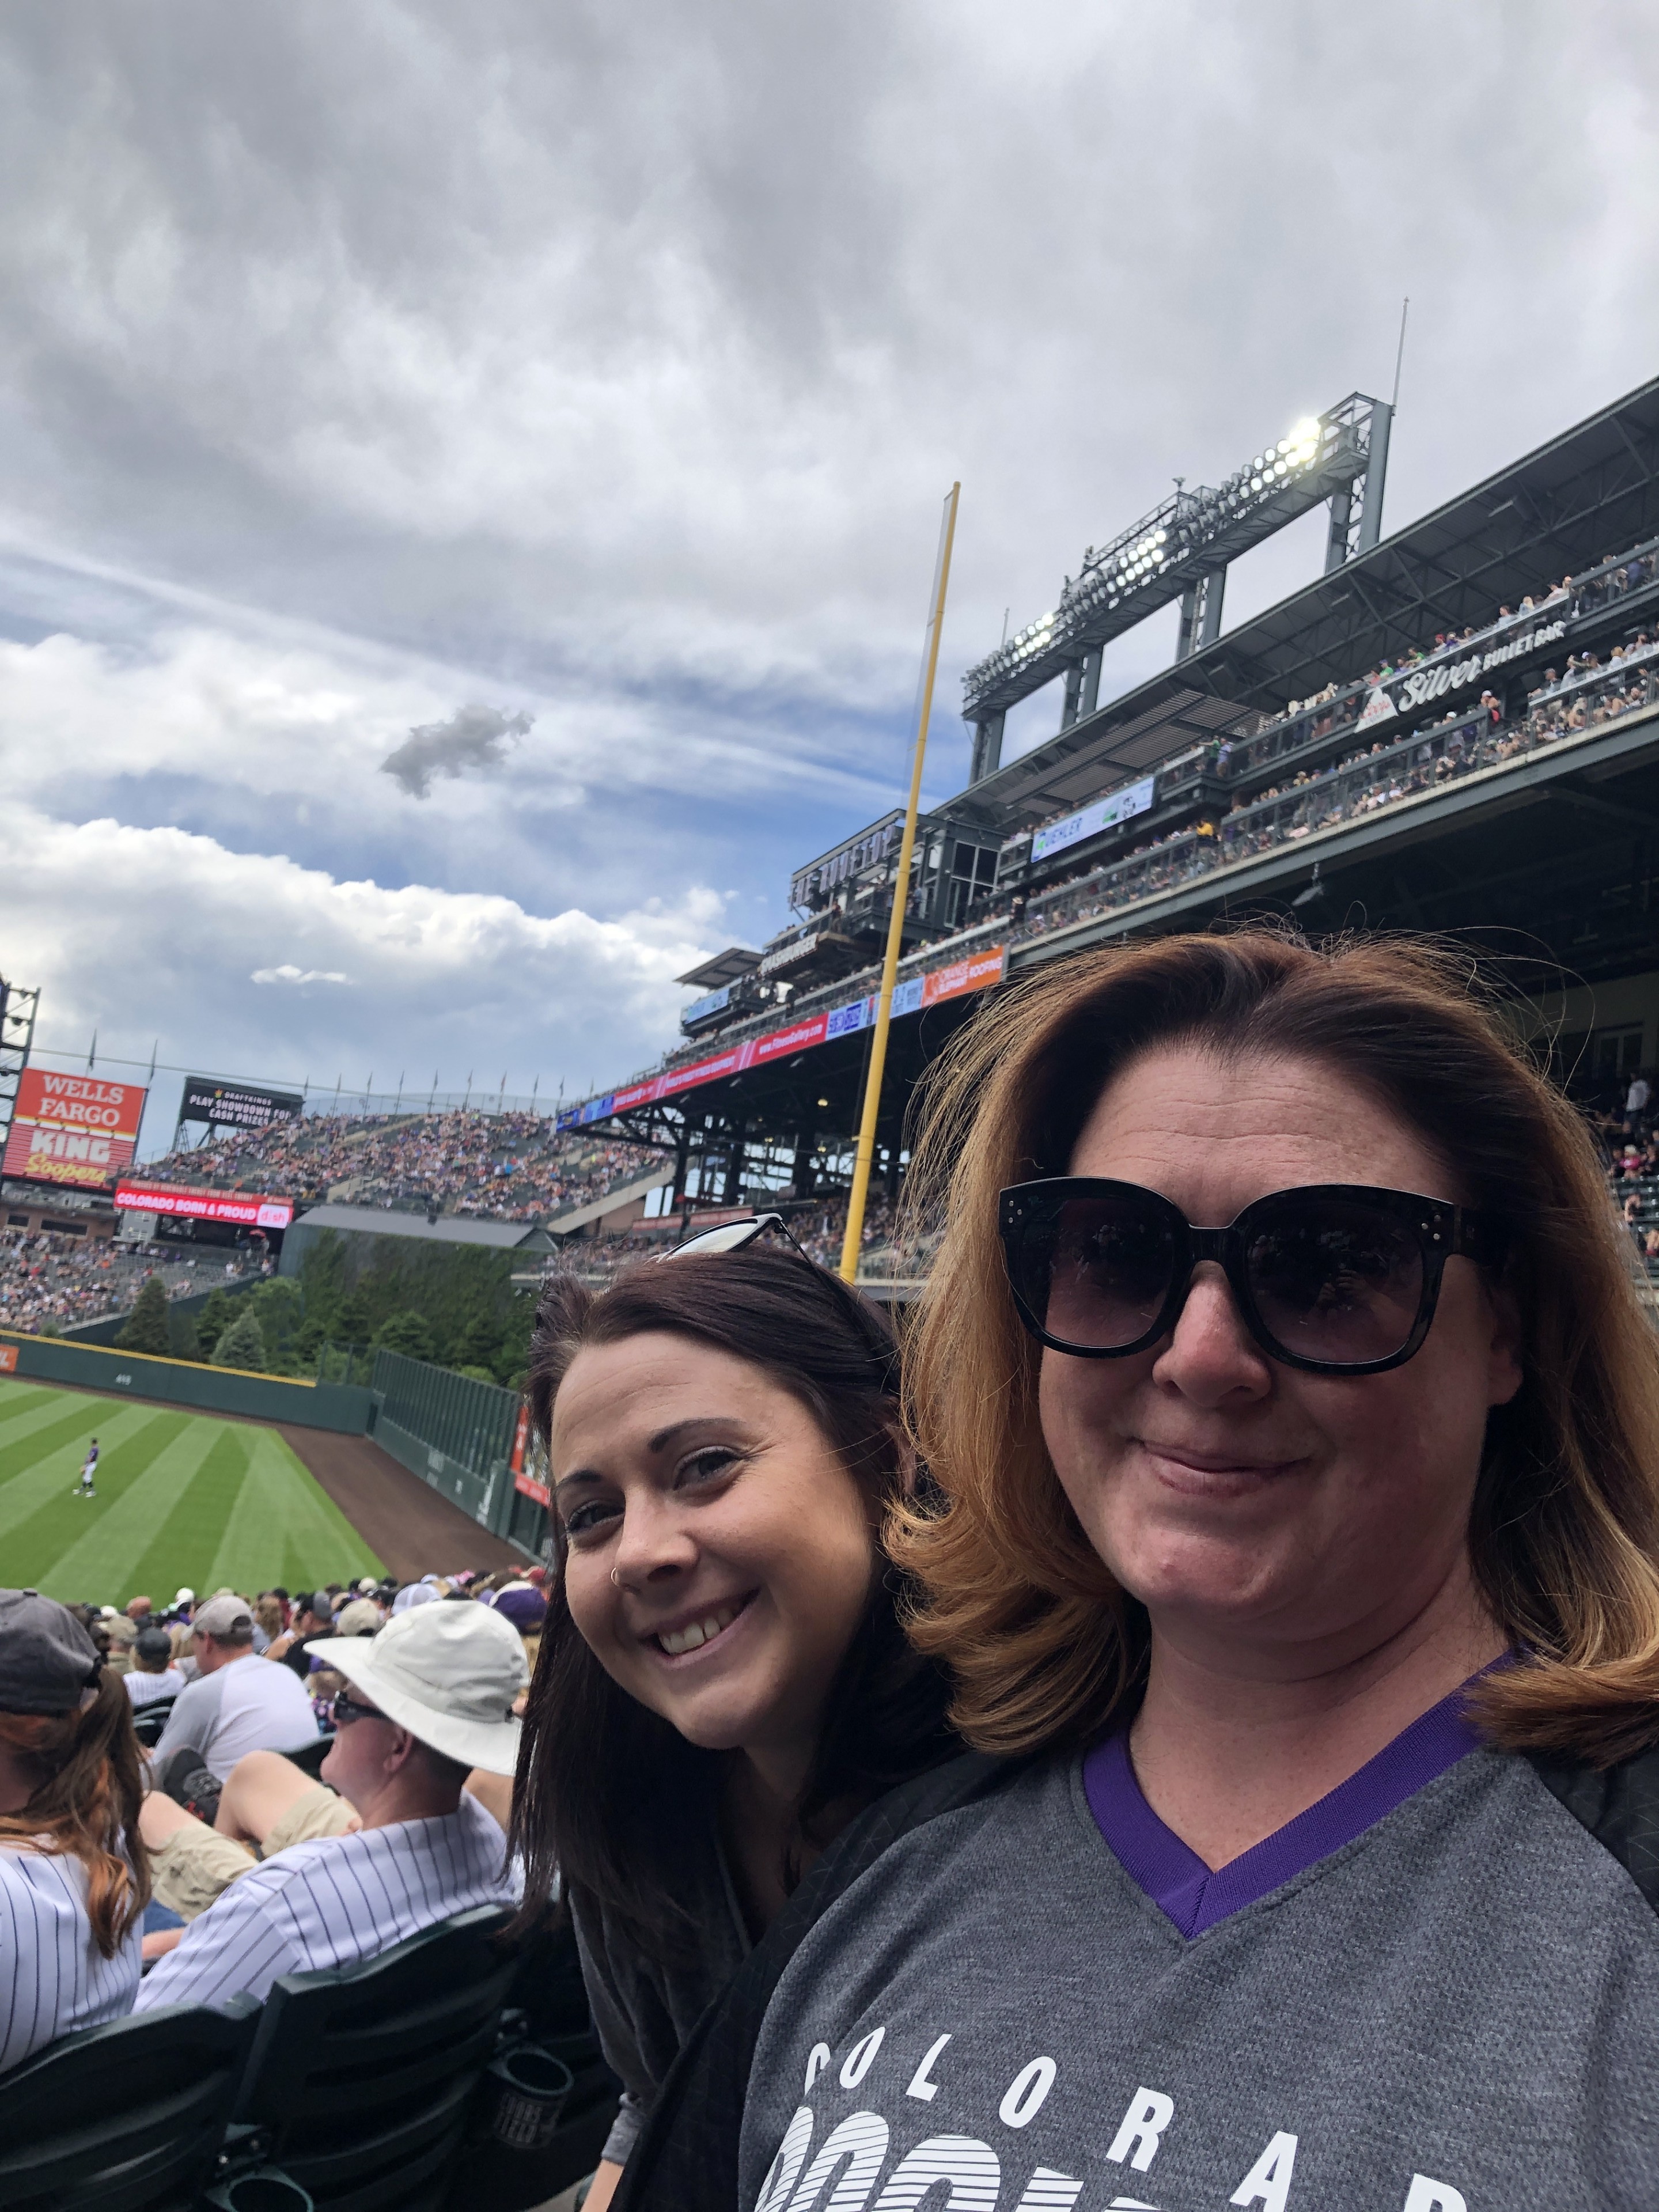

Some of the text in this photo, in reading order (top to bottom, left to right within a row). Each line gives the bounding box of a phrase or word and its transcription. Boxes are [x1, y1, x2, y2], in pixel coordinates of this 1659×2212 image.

[1398, 620, 1568, 713] Silver BULLET BAR
[969, 956, 1003, 979] ROOFING
[43, 1074, 124, 1105] WELLS
[224, 1091, 272, 1106] DRAFTKINGS
[38, 1097, 120, 1127] FARGO
[189, 1094, 214, 1108] PLAY
[215, 1099, 272, 1118] SHOWDOWN
[208, 1108, 269, 1126] CASH PRIZES
[31, 1130, 111, 1164] KING
[25, 1153, 107, 1183] Soopers
[116, 1192, 257, 1221] COLORADO BORN & PROUD
[261, 1209, 285, 1222] dish
